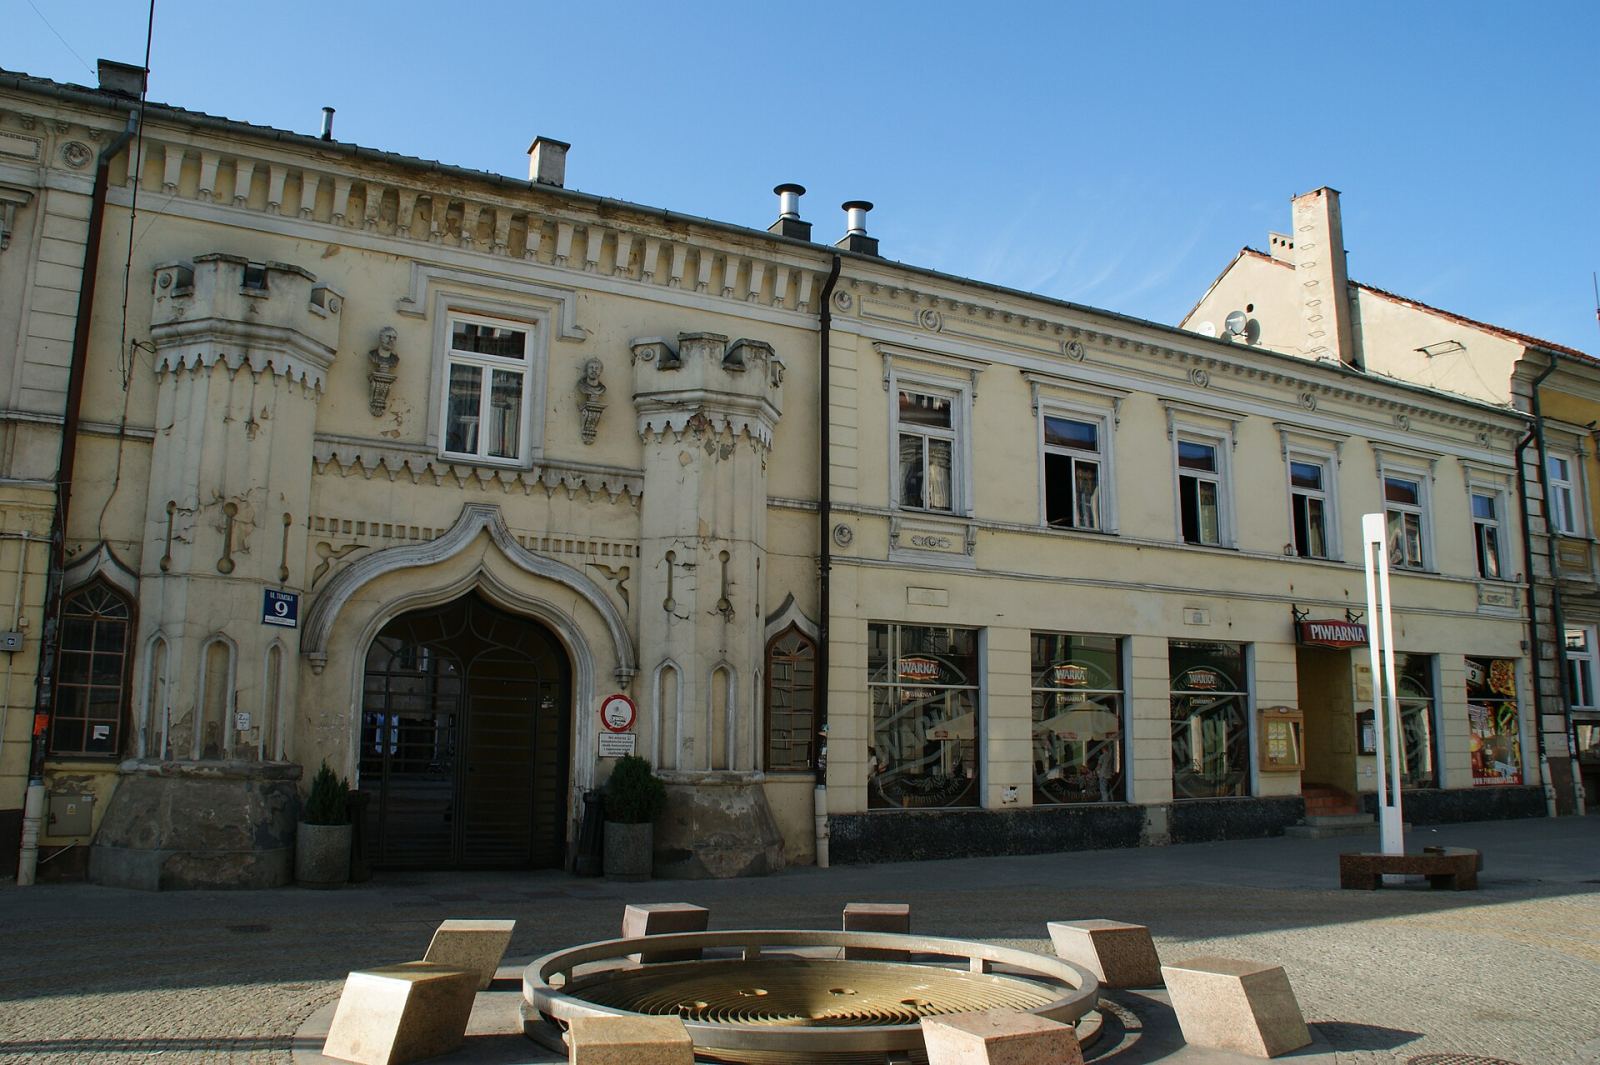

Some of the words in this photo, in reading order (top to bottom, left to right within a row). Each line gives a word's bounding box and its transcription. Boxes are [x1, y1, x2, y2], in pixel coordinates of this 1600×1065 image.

[274, 601, 288, 617] 9
[1310, 624, 1365, 642] PIWIARNIA
[1056, 669, 1085, 681] WARKA
[1471, 670, 1477, 680] 9
